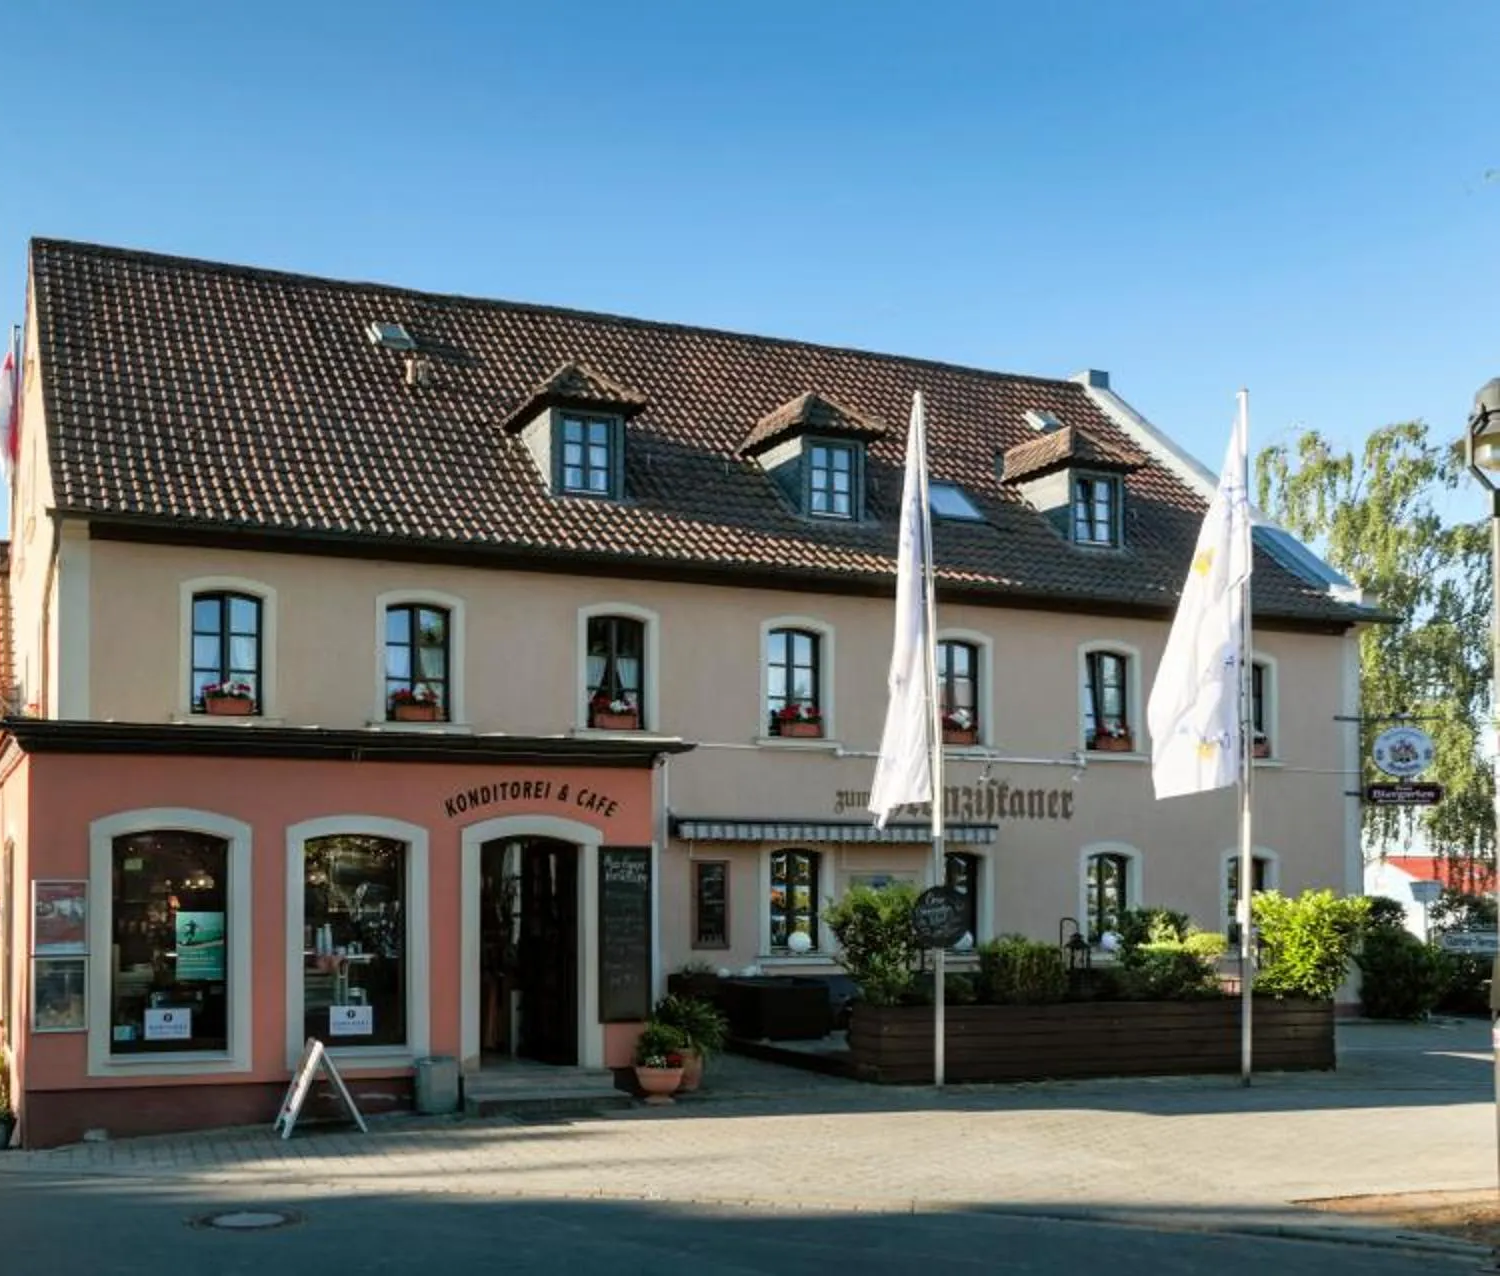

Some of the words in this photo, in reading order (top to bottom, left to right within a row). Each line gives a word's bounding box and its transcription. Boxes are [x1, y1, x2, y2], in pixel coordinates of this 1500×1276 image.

[444, 781, 552, 818] KONDITOREI
[557, 783, 569, 803] &
[576, 789, 618, 818] CAFE
